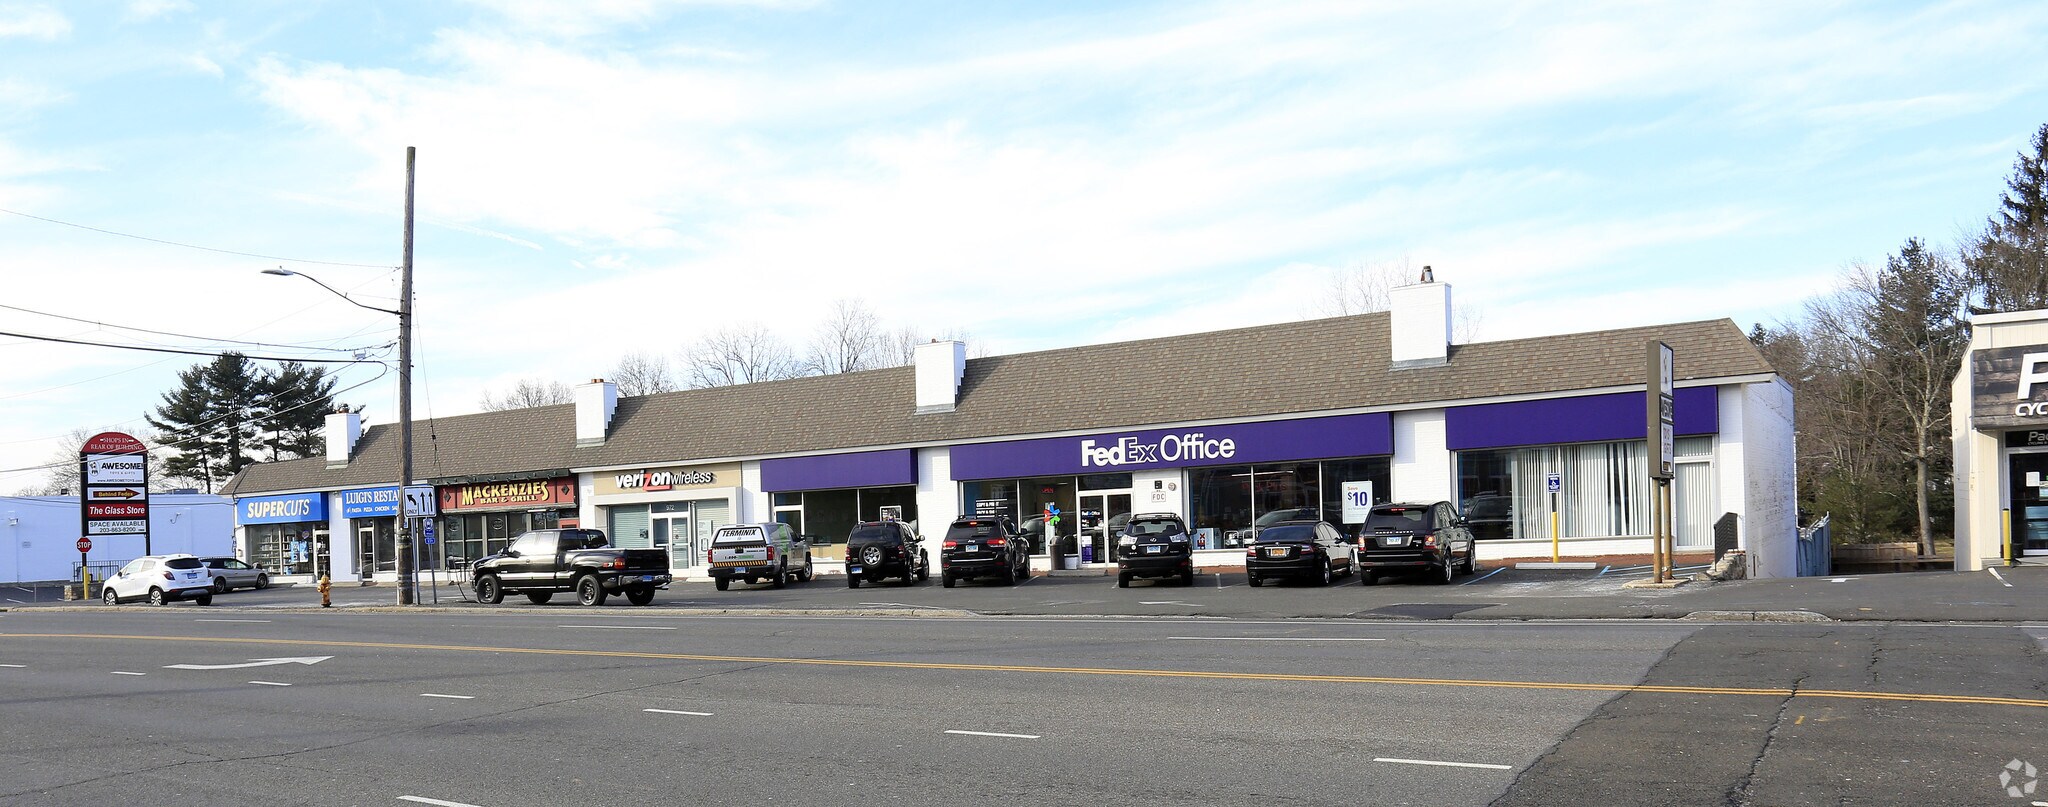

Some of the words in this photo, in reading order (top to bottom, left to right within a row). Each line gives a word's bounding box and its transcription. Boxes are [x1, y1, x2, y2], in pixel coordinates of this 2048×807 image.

[1081, 437, 1158, 467] FedEx
[1160, 433, 1236, 462] Office
[461, 481, 549, 506] MACKENZIES
[1347, 491, 1368, 507] $10
[90, 506, 103, 515] The
[105, 505, 125, 514] Glass
[126, 505, 145, 514] Store
[247, 498, 310, 518] SUPERCUTS
[723, 529, 757, 537] TERMINIX
